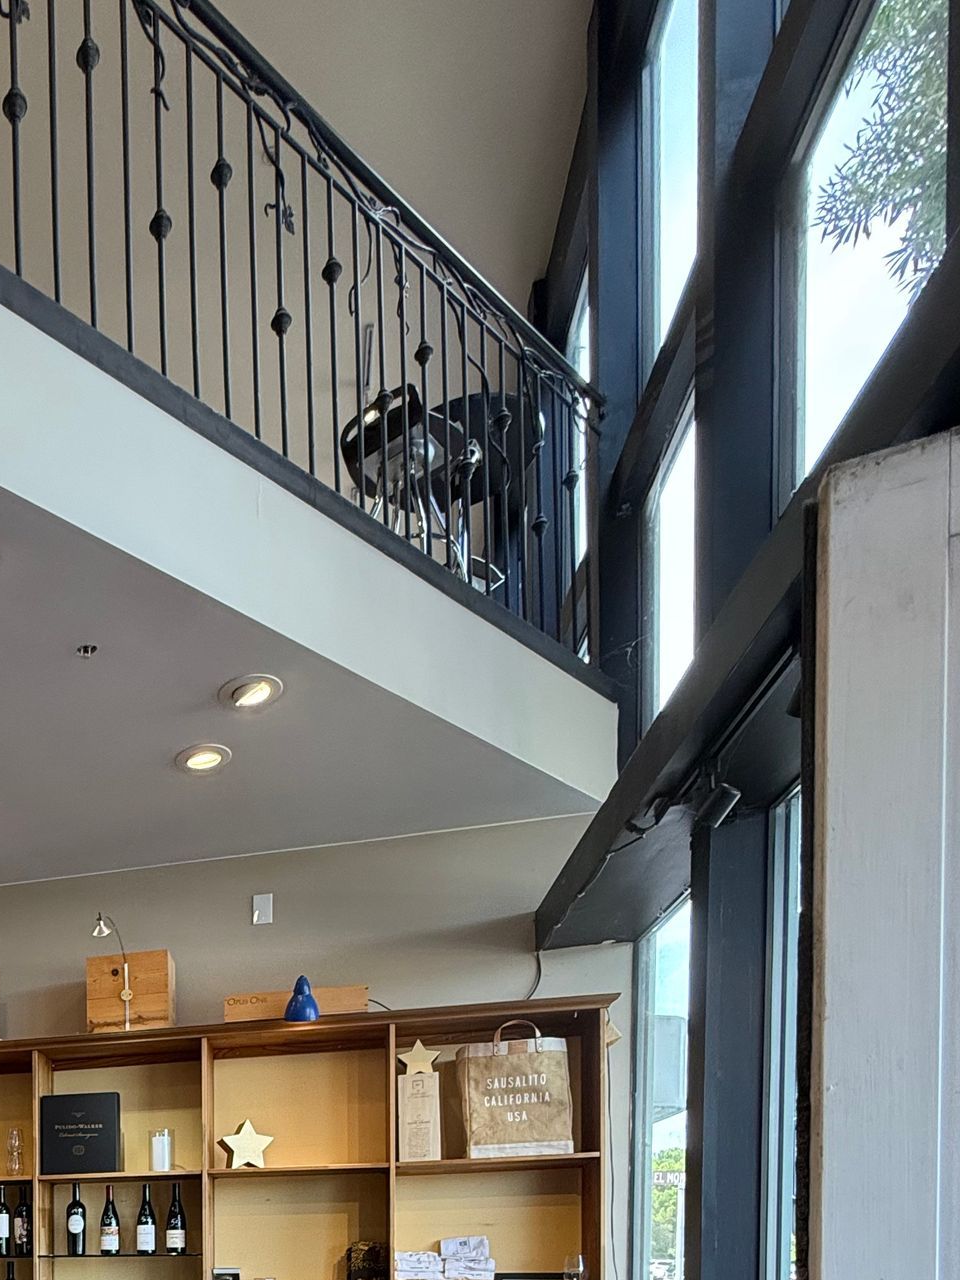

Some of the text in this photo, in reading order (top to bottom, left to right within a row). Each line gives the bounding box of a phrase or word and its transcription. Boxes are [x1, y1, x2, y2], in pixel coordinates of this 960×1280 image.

[486, 1073, 547, 1090] SAUSALITO
[484, 1092, 551, 1107] CALIFORNIA
[507, 1111, 528, 1122] USA
[654, 1172, 665, 1183] EL
